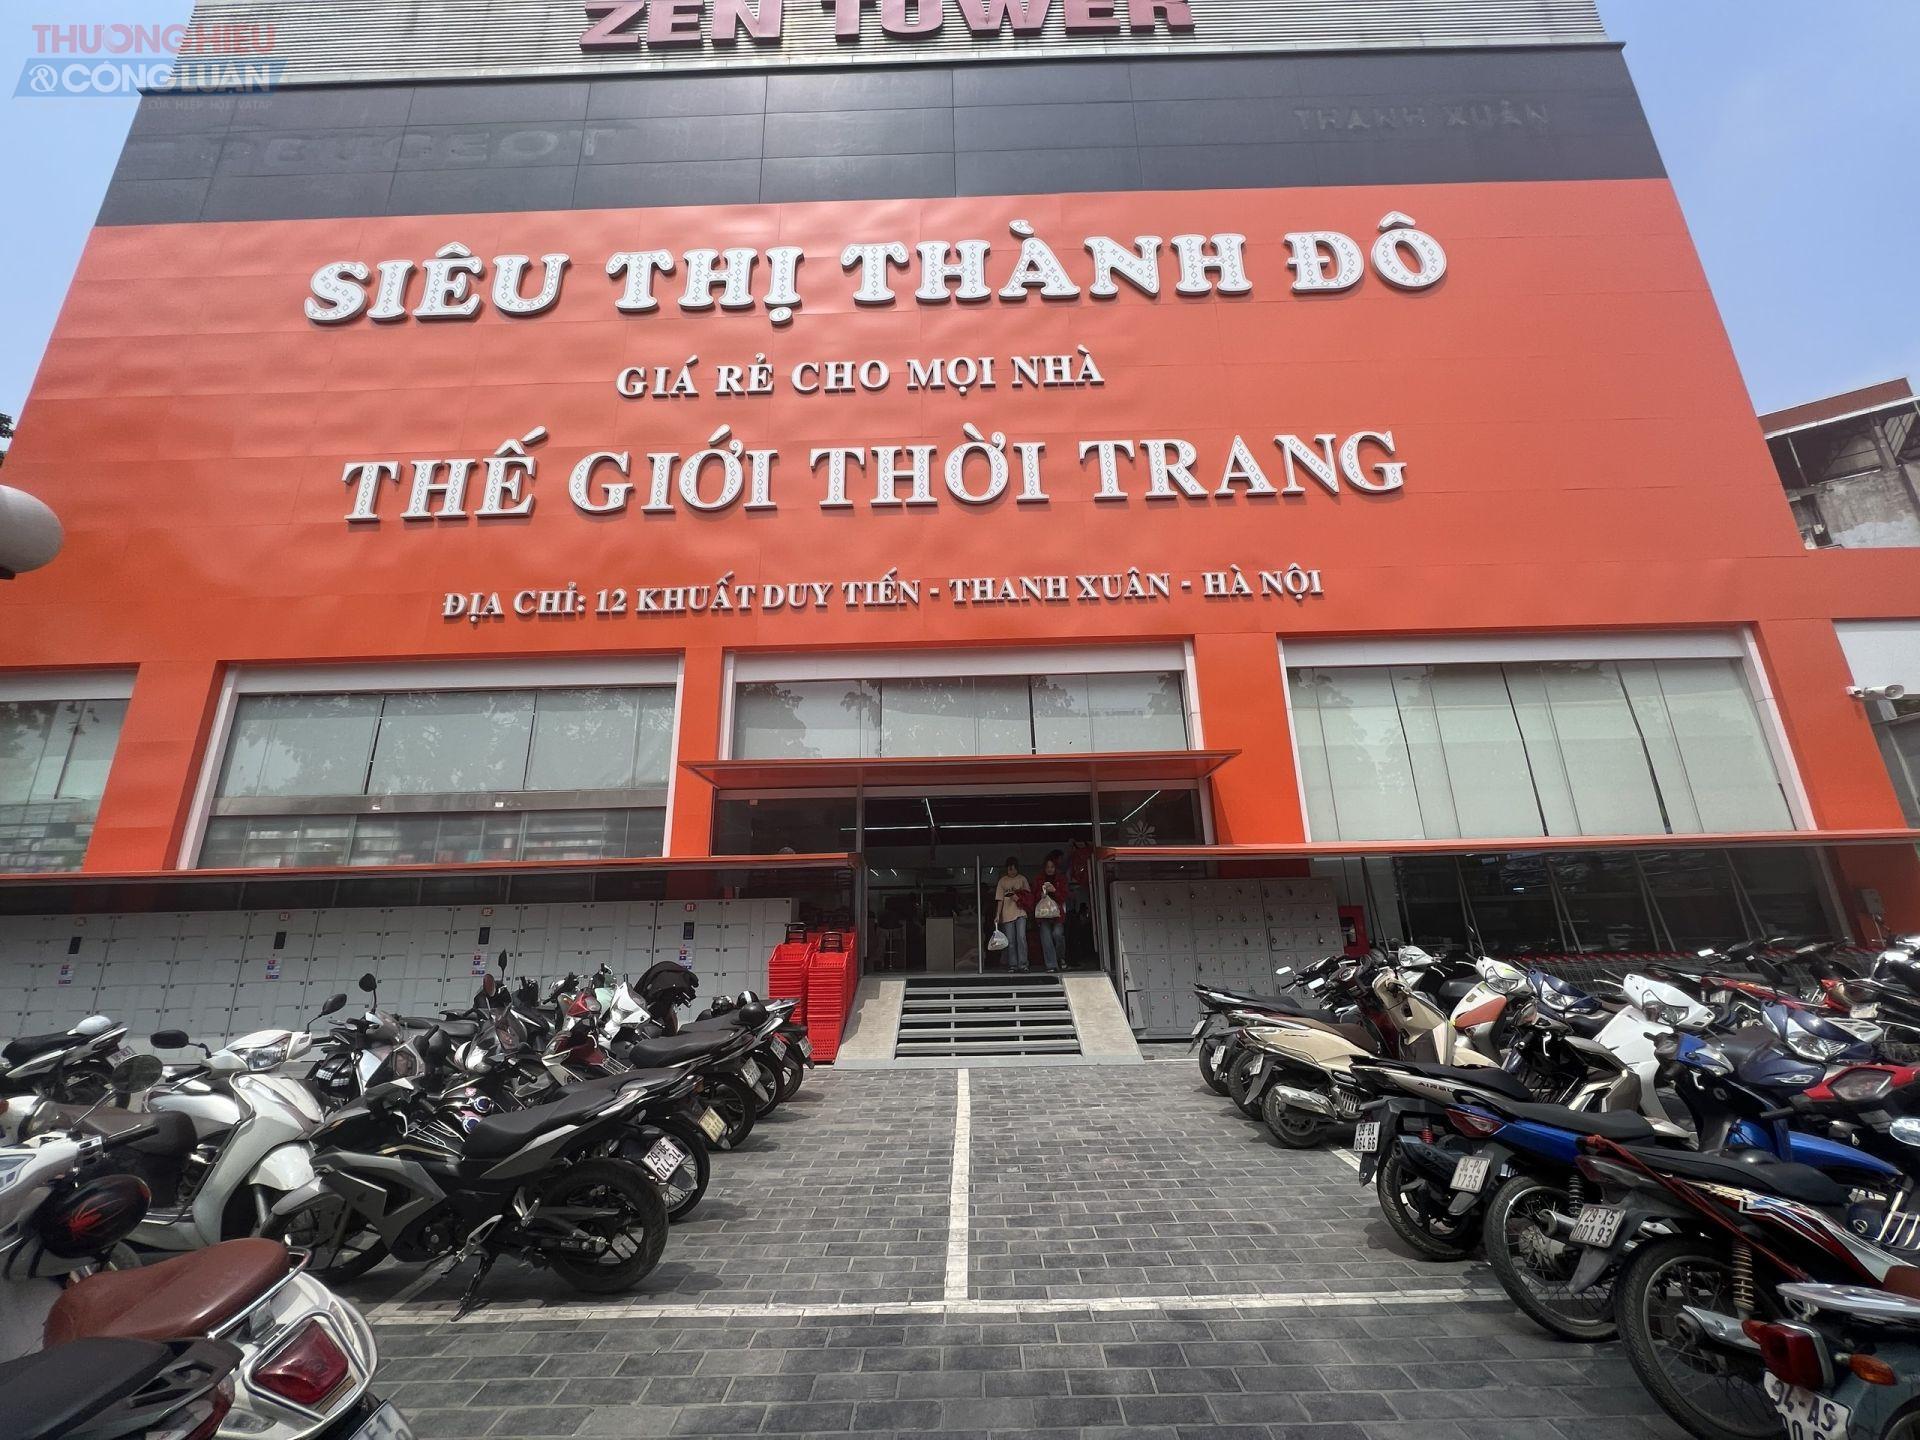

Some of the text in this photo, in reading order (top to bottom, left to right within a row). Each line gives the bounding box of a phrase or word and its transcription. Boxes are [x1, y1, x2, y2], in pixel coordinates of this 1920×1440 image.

[579, 0, 1195, 51] ZEN TOWER
[304, 211, 1447, 326] SIÊU THỊ THÀNH ĐÔ
[616, 344, 1105, 399] GIÁ RẺ CHO MỌI NHÀ
[342, 422, 1407, 523] THẾ GIỚI THỜI TRANG
[442, 592, 505, 623] ĐỊA
[513, 581, 586, 615] CHỈ:
[595, 588, 627, 612] 12
[636, 571, 756, 612] KHUẤT
[762, 582, 832, 608] DUY
[842, 567, 919, 606] TIẾN
[949, 575, 1069, 604] THANH
[1077, 567, 1170, 600] XUÂN
[1203, 564, 1252, 596] HÀ
[1261, 563, 1323, 600] NỘI
[1456, 1173, 1479, 1189] 1735
[1573, 1223, 1613, 1244] 001.93
